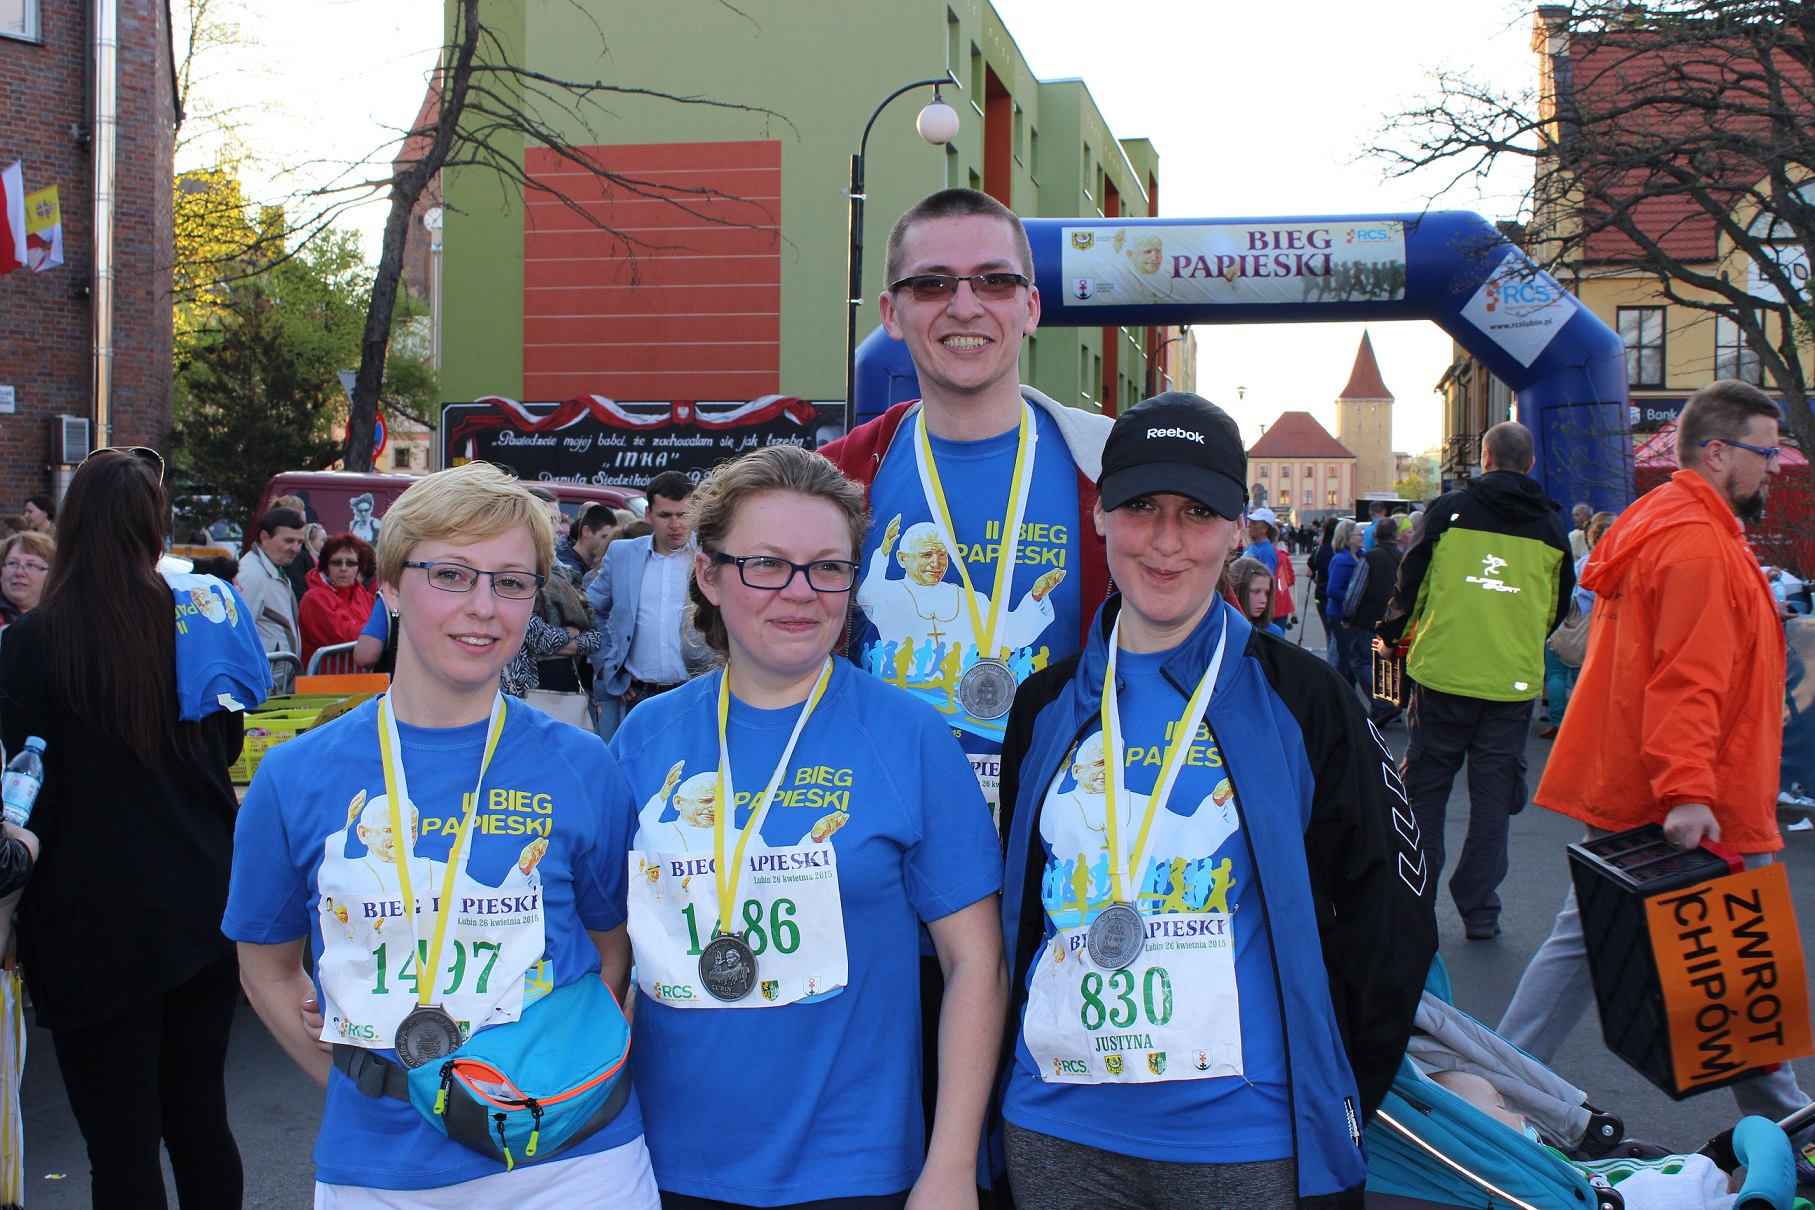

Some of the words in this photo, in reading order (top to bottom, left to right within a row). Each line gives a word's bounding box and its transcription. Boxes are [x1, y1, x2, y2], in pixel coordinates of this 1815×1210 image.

[1246, 228, 1333, 251] BIEG
[1171, 252, 1334, 279] PAPIESKI
[1489, 318, 1553, 330] www.rcslubin.pl
[1646, 408, 1677, 421] Bank
[563, 434, 593, 453] mojej
[735, 434, 758, 452] jak
[1146, 427, 1205, 444] Reebok
[985, 520, 1000, 540] II
[1018, 523, 1068, 544] BIEG
[957, 544, 1066, 567] PAPESKI
[1125, 746, 1223, 768] PAES
[794, 766, 854, 787] BIEG
[489, 789, 553, 815] BIEG
[753, 876, 771, 884] Lubin
[772, 875, 781, 884] 26
[782, 873, 813, 882] kwietnia
[814, 870, 833, 880] 2015
[457, 917, 478, 926] Lubin
[479, 918, 489, 927] 26
[490, 916, 521, 927] kwietnia
[522, 914, 539, 924] 2015
[682, 898, 801, 956] 186
[1145, 943, 1164, 952] Lubin
[1165, 941, 1175, 950] 26
[1176, 940, 1207, 950] kwietnia
[1208, 939, 1227, 948] 2015
[1723, 888, 1785, 1046] ZWROT
[1674, 892, 1742, 1080] CHIPÓW
[1080, 966, 1173, 1031] 830
[1095, 1033, 1154, 1052] JUSTYNA
